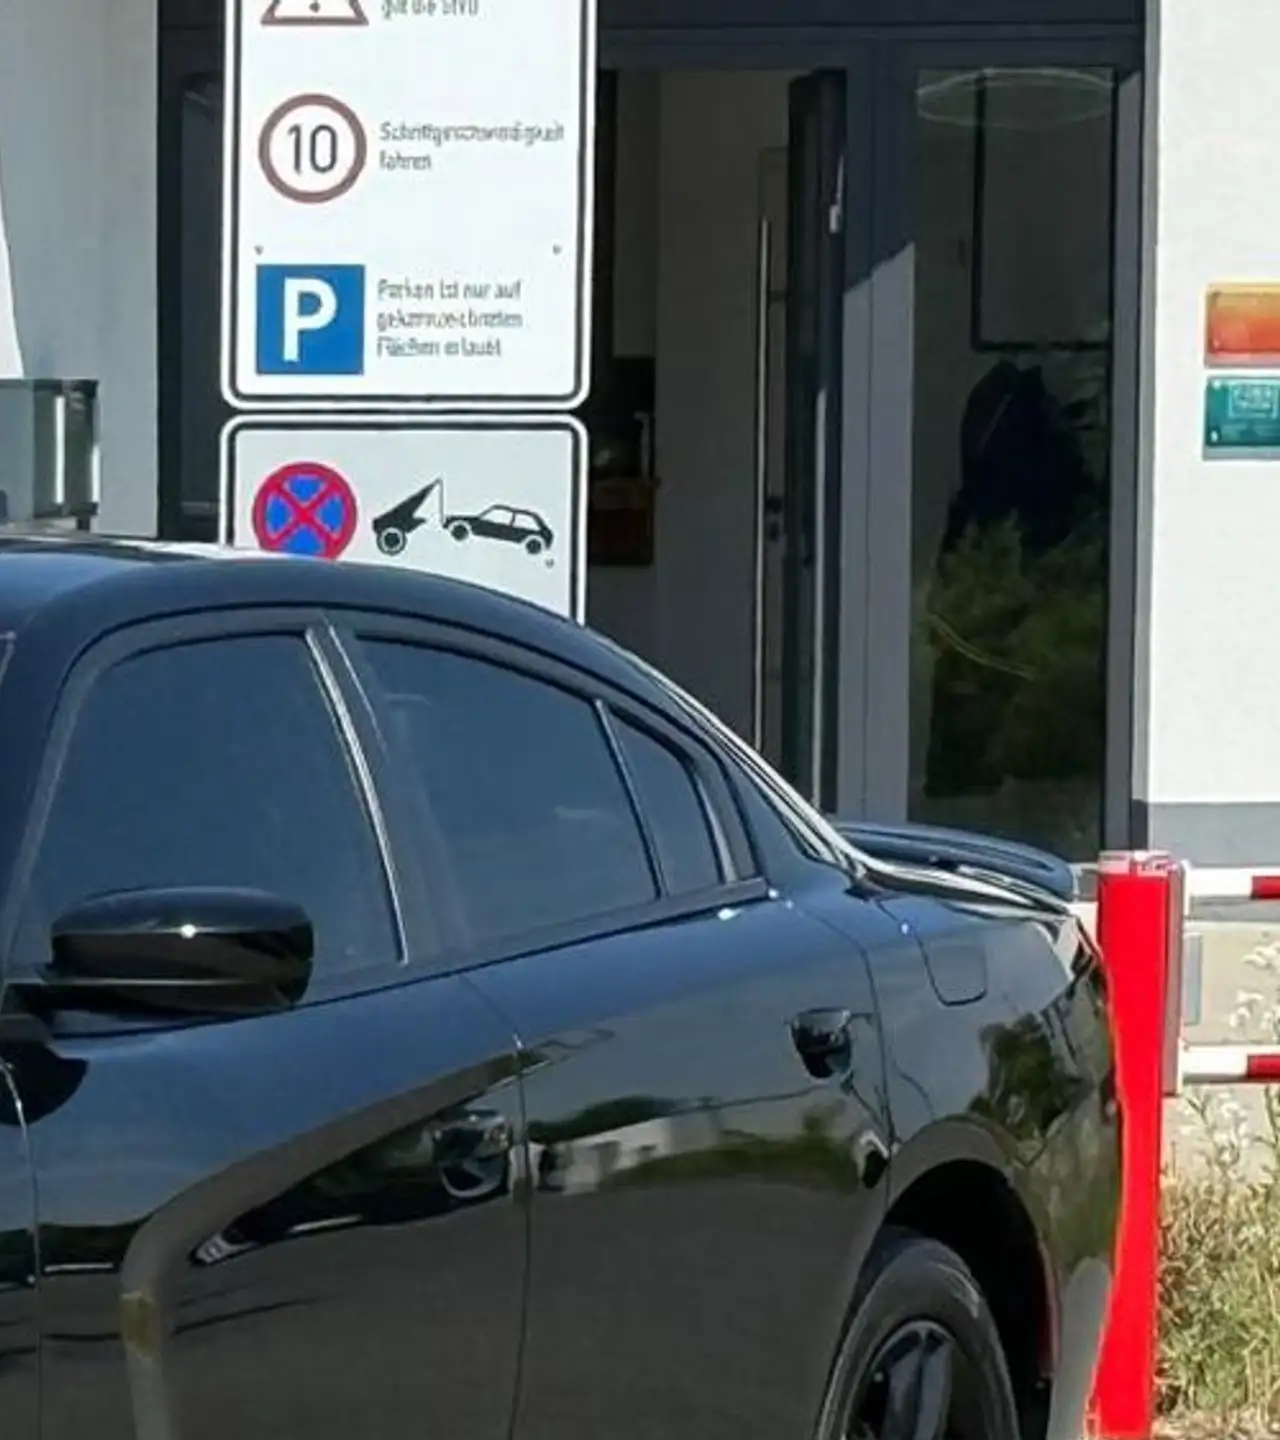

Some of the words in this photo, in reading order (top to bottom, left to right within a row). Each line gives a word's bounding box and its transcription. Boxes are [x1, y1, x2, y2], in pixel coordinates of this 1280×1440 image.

[287, 123, 338, 175] 10
[463, 283, 490, 299] nur
[283, 277, 338, 362] P
